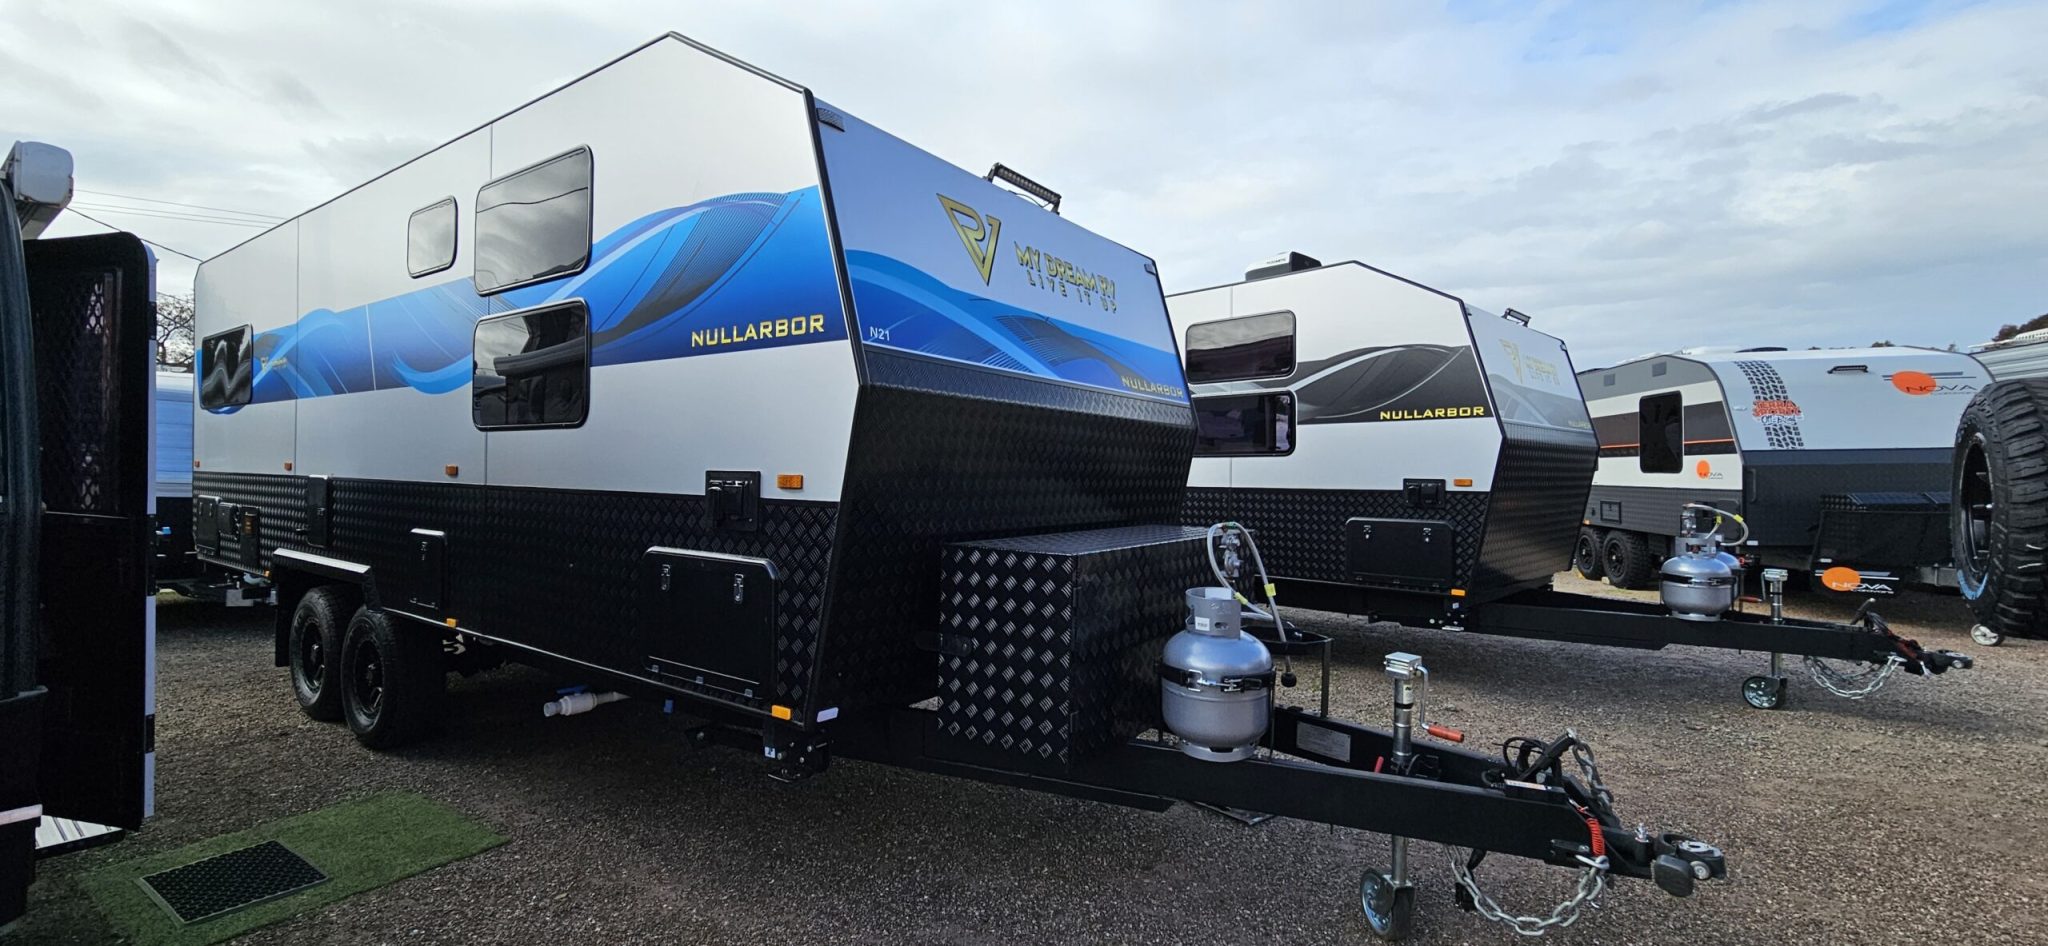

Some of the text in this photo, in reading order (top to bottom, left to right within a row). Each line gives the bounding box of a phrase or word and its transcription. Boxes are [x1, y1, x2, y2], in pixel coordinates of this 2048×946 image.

[1013, 241, 1116, 300] MY DREAM RV
[1026, 269, 1068, 298] LIVE
[1076, 287, 1092, 306] IT
[691, 313, 825, 348] NULLARBOR
[869, 325, 890, 341] N21
[1120, 375, 1184, 398] NULLARBOR
[1905, 384, 1977, 393] NOVA
[1379, 406, 1485, 420] NULLARBOR
[1832, 581, 1893, 591] NOVA
